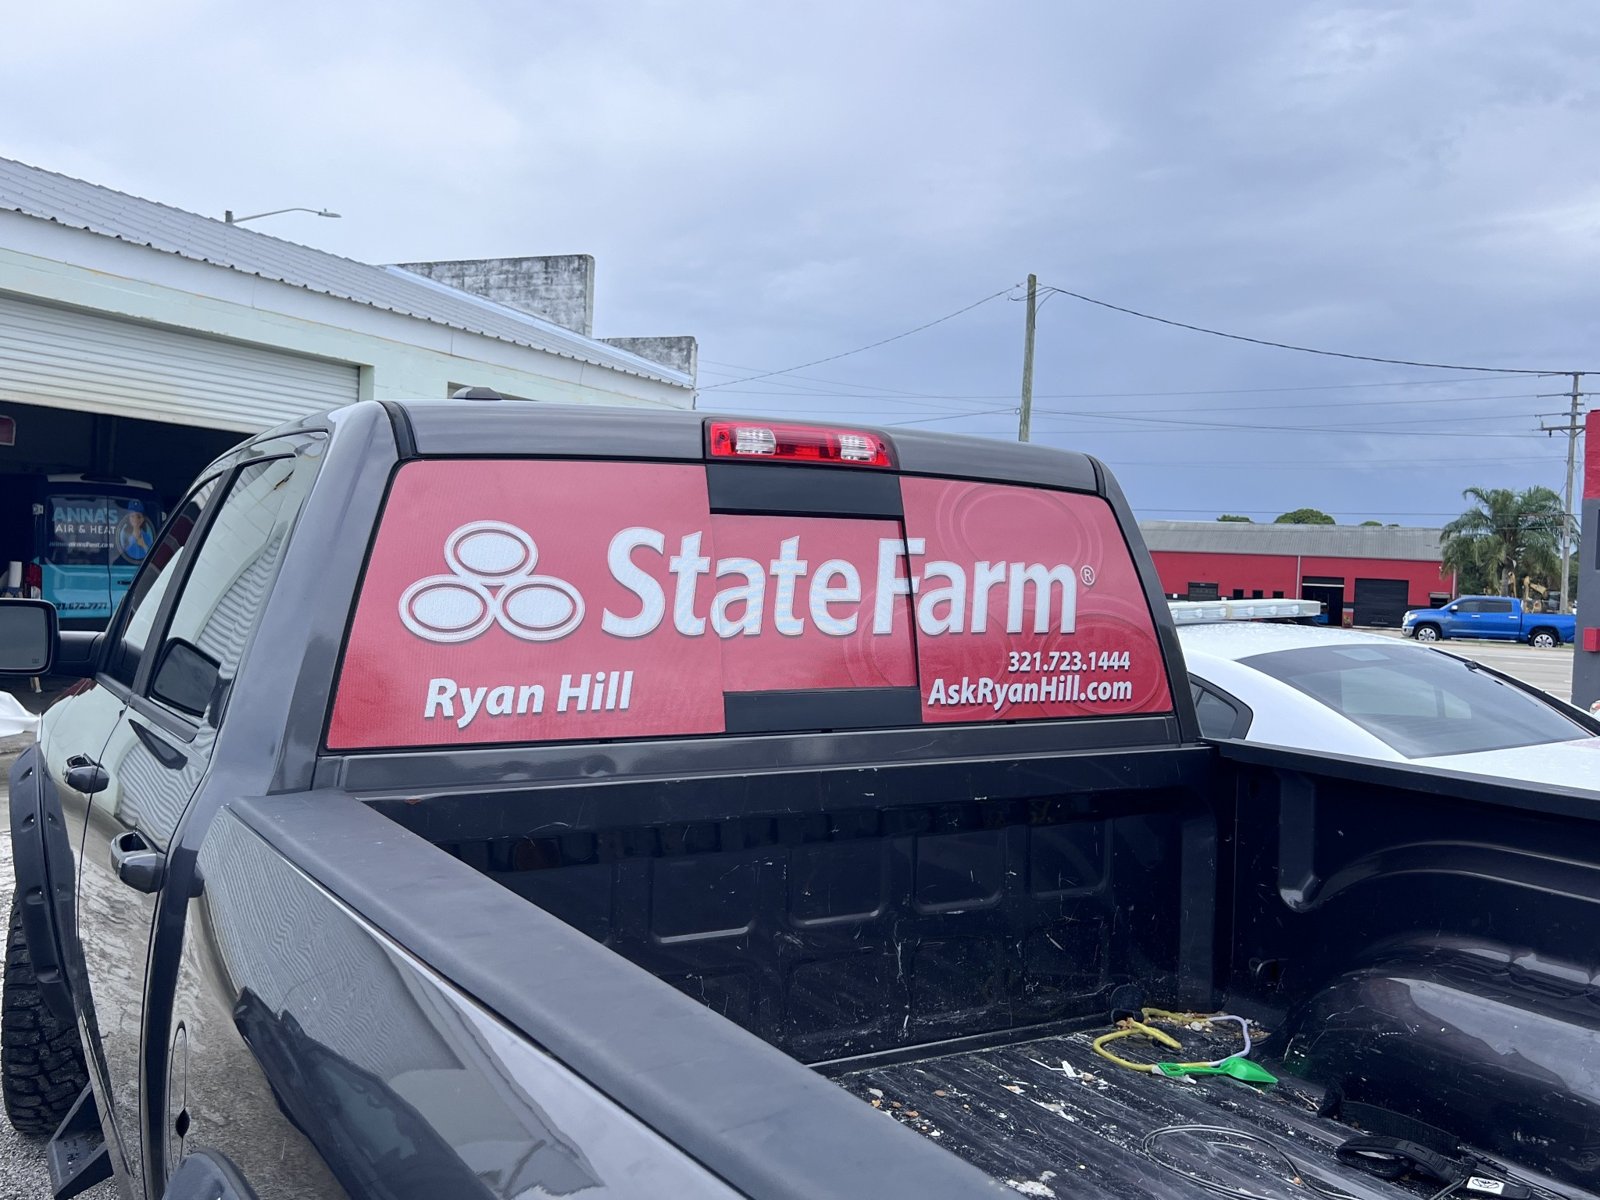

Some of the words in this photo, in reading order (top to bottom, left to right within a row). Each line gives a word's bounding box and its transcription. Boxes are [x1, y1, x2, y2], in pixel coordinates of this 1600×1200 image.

[52, 507, 118, 525] ANNA'S
[55, 523, 74, 533] AIR
[78, 524, 86, 534] &
[90, 525, 116, 535] HEAT
[1007, 651, 1131, 673] 321.723.1444
[424, 678, 545, 729] Ryan
[556, 670, 634, 712] Hill
[927, 674, 1133, 710] AskRyanHill.com
